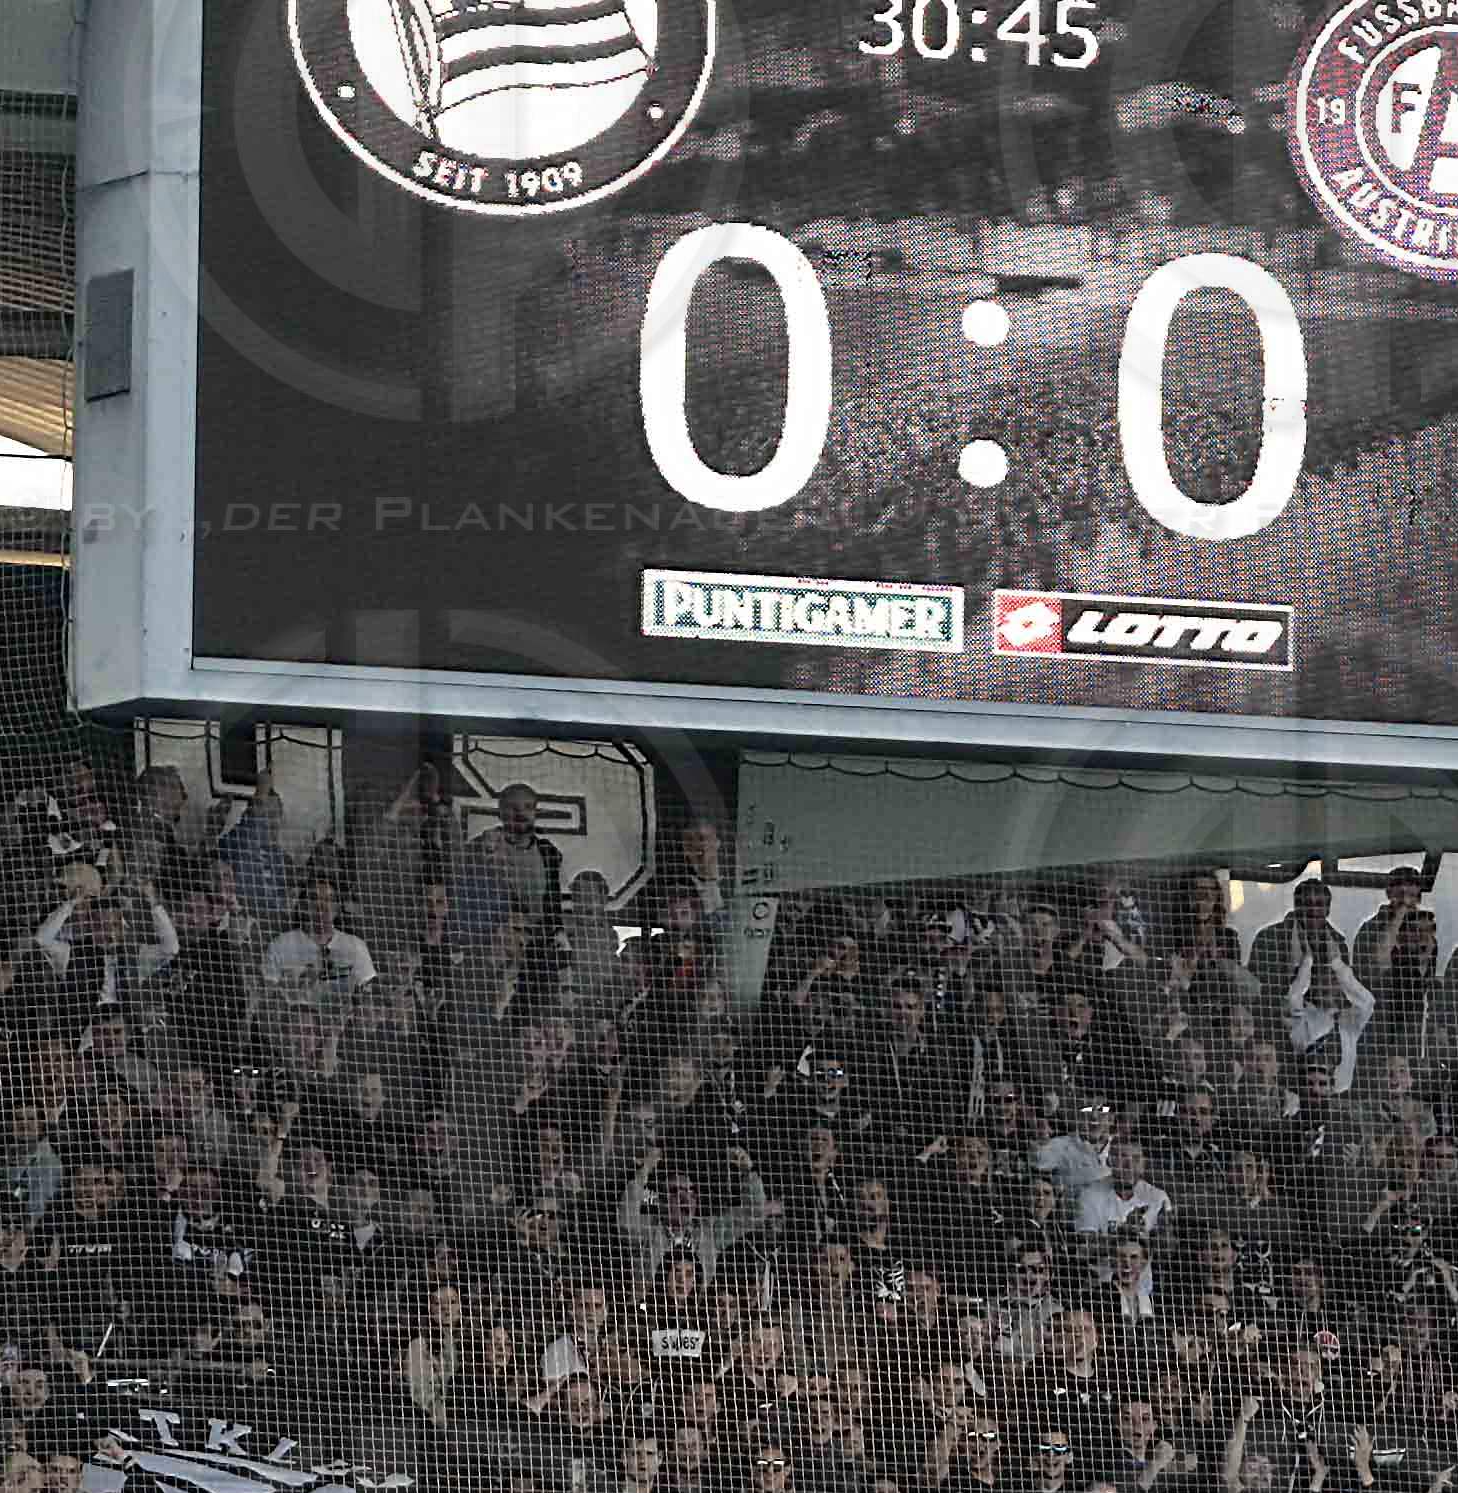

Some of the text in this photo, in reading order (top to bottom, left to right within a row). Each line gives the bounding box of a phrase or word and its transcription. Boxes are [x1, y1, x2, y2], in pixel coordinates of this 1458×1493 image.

[412, 151, 583, 198] SEIT 1909
[663, 580, 946, 641] PUNTIGAMER
[1068, 610, 1282, 655] LOTTO
